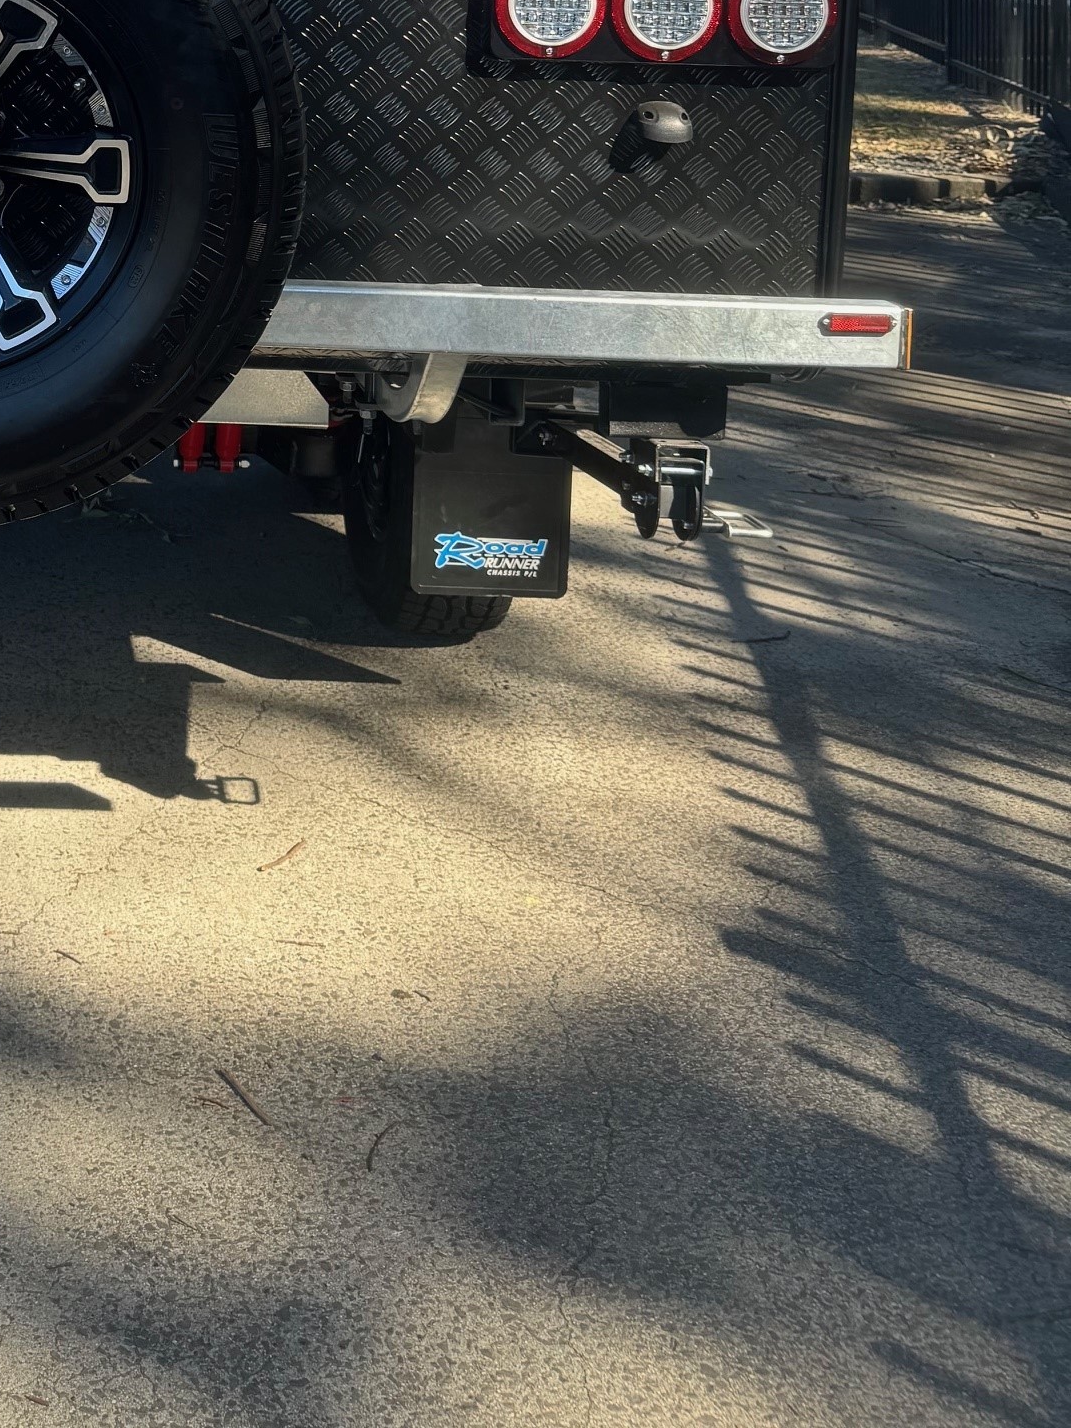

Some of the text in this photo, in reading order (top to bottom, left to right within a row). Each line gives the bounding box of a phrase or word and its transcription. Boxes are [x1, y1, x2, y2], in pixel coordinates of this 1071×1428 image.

[434, 531, 549, 569] Road
[484, 557, 541, 570] RUNNER
[486, 569, 537, 578] CHASSIS P/L
